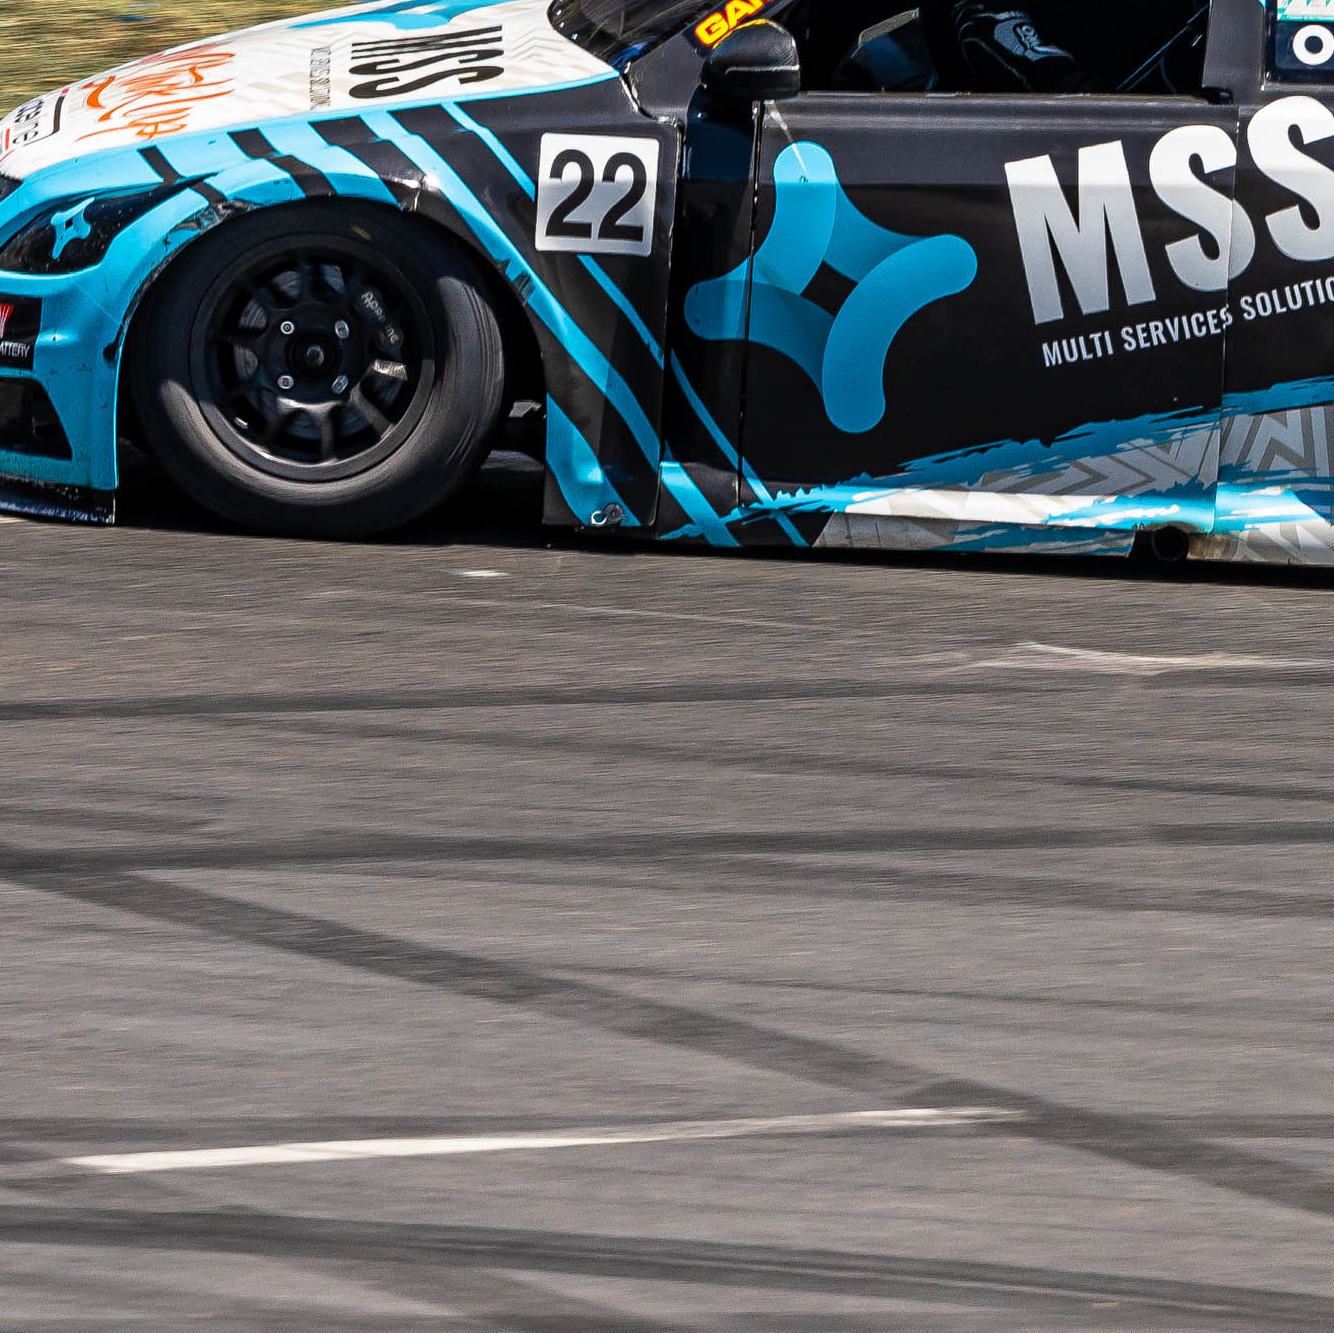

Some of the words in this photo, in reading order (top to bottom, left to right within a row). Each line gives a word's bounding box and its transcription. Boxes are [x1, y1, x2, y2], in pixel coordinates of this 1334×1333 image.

[349, 24, 504, 99] MSS
[545, 148, 648, 242] 22
[1041, 330, 1114, 368] MULTI
[1121, 303, 1234, 353] SERVICES
